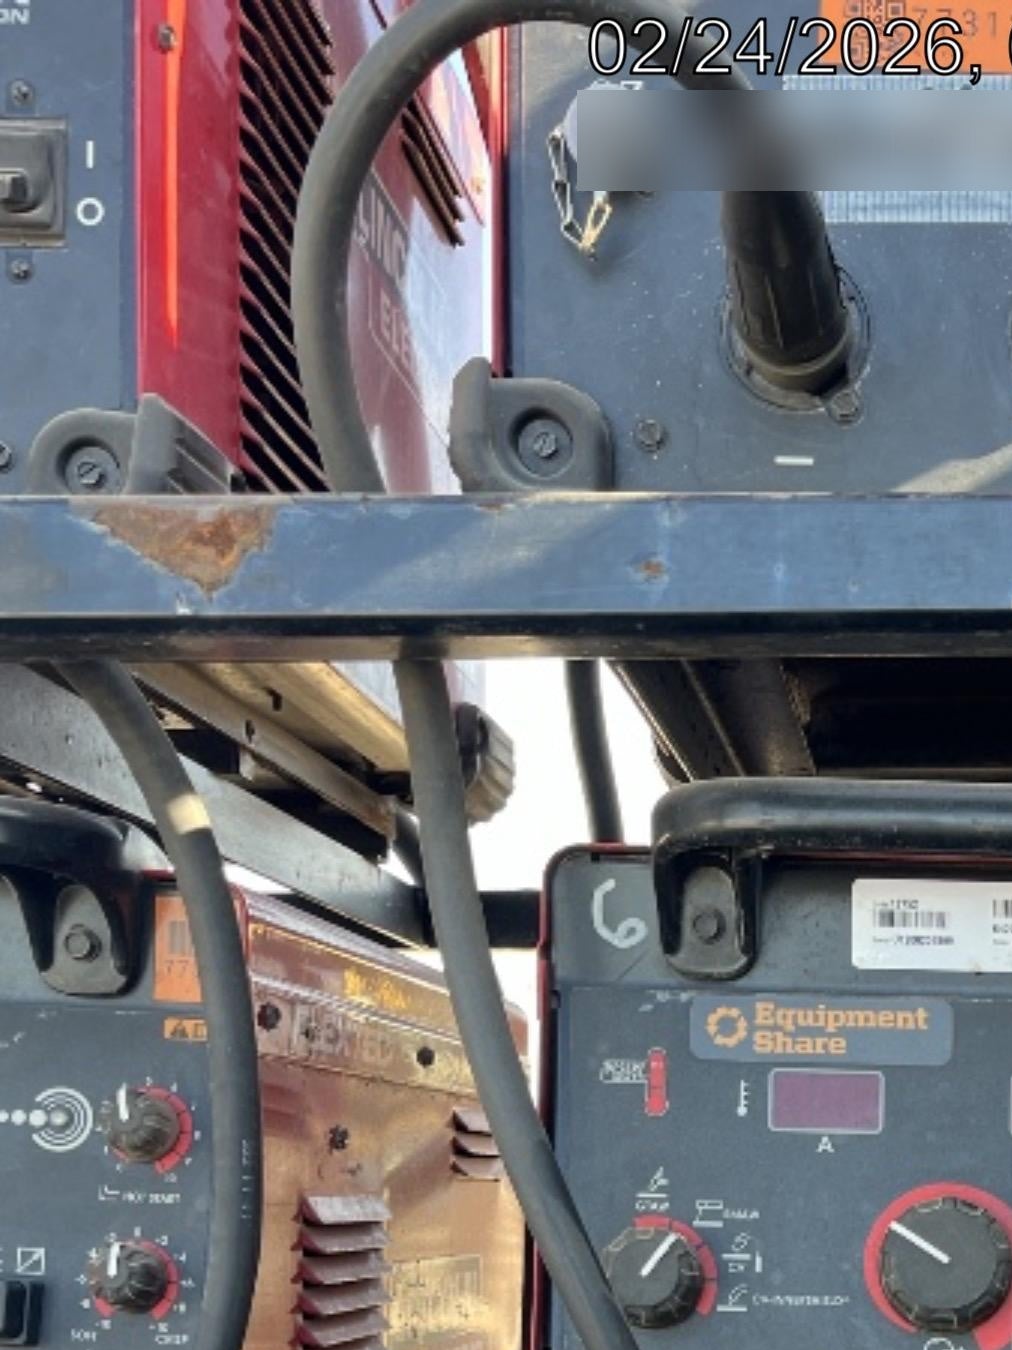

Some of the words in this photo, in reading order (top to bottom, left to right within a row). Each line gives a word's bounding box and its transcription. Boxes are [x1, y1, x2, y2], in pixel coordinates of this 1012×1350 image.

[754, 1001, 929, 1032] Equipment
[753, 1030, 847, 1055] Share
[816, 1135, 835, 1153] A
